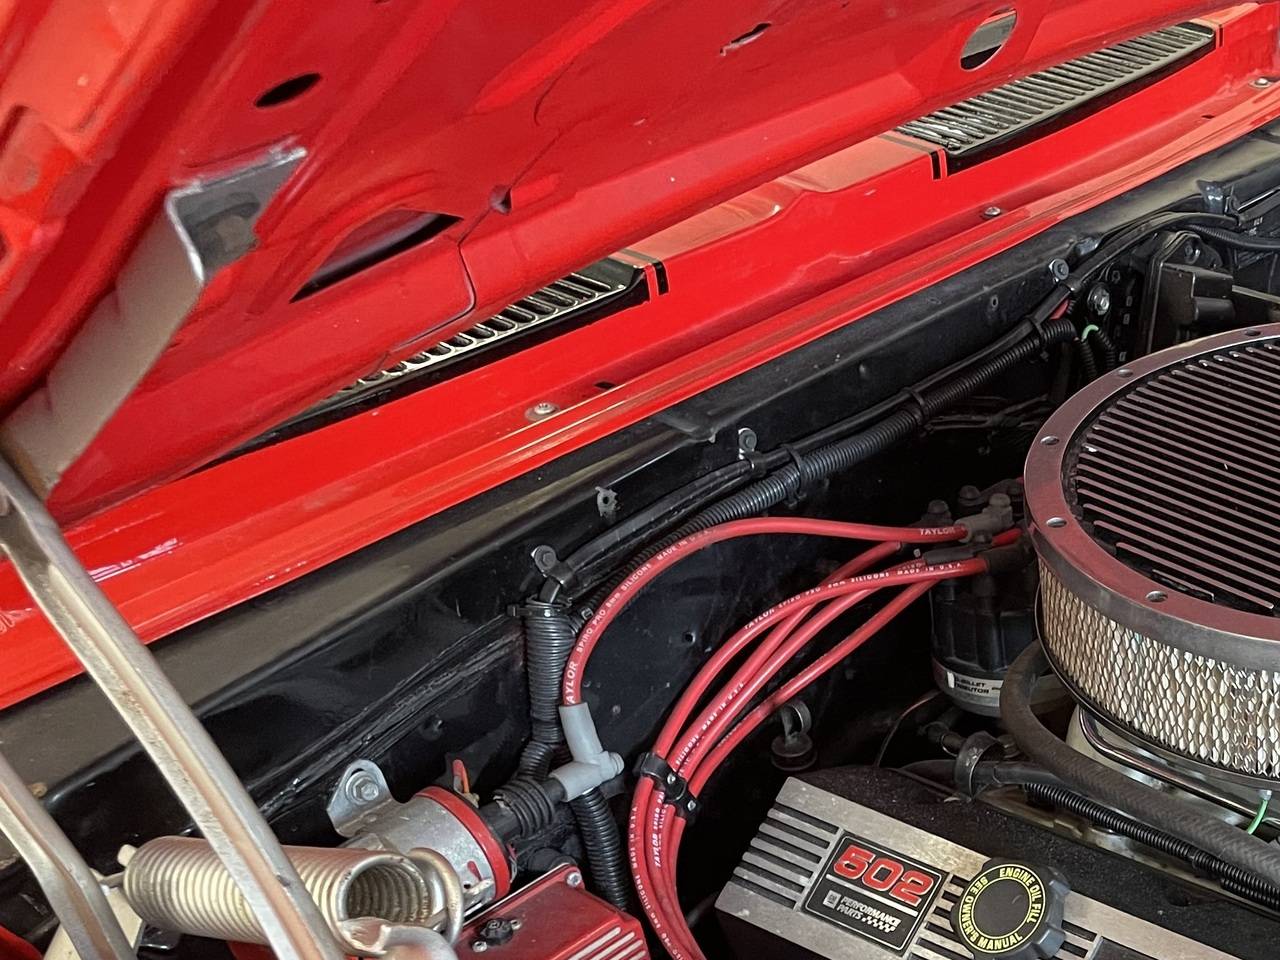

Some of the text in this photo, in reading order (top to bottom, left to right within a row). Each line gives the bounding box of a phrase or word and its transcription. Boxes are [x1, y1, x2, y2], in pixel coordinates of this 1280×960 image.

[920, 527, 955, 535] TAYLOR
[564, 660, 579, 705] AYLOR
[576, 627, 593, 653] SPIRO
[592, 609, 606, 626] PRO
[621, 562, 652, 590] SILICONE
[656, 545, 679, 560] MADE
[679, 540, 688, 550] IN
[744, 608, 775, 630] TAYLOR
[851, 572, 889, 583] SILICONE
[897, 568, 920, 576] MADE
[652, 833, 662, 867] TAYLOR
[833, 844, 934, 907] 502
[836, 904, 863, 920] PARTS
[840, 896, 901, 926] PERFORMANCE
[961, 876, 1023, 950] SEE OWNER'S MANUAL
[999, 867, 1042, 923] ENGINE OIL FILL
